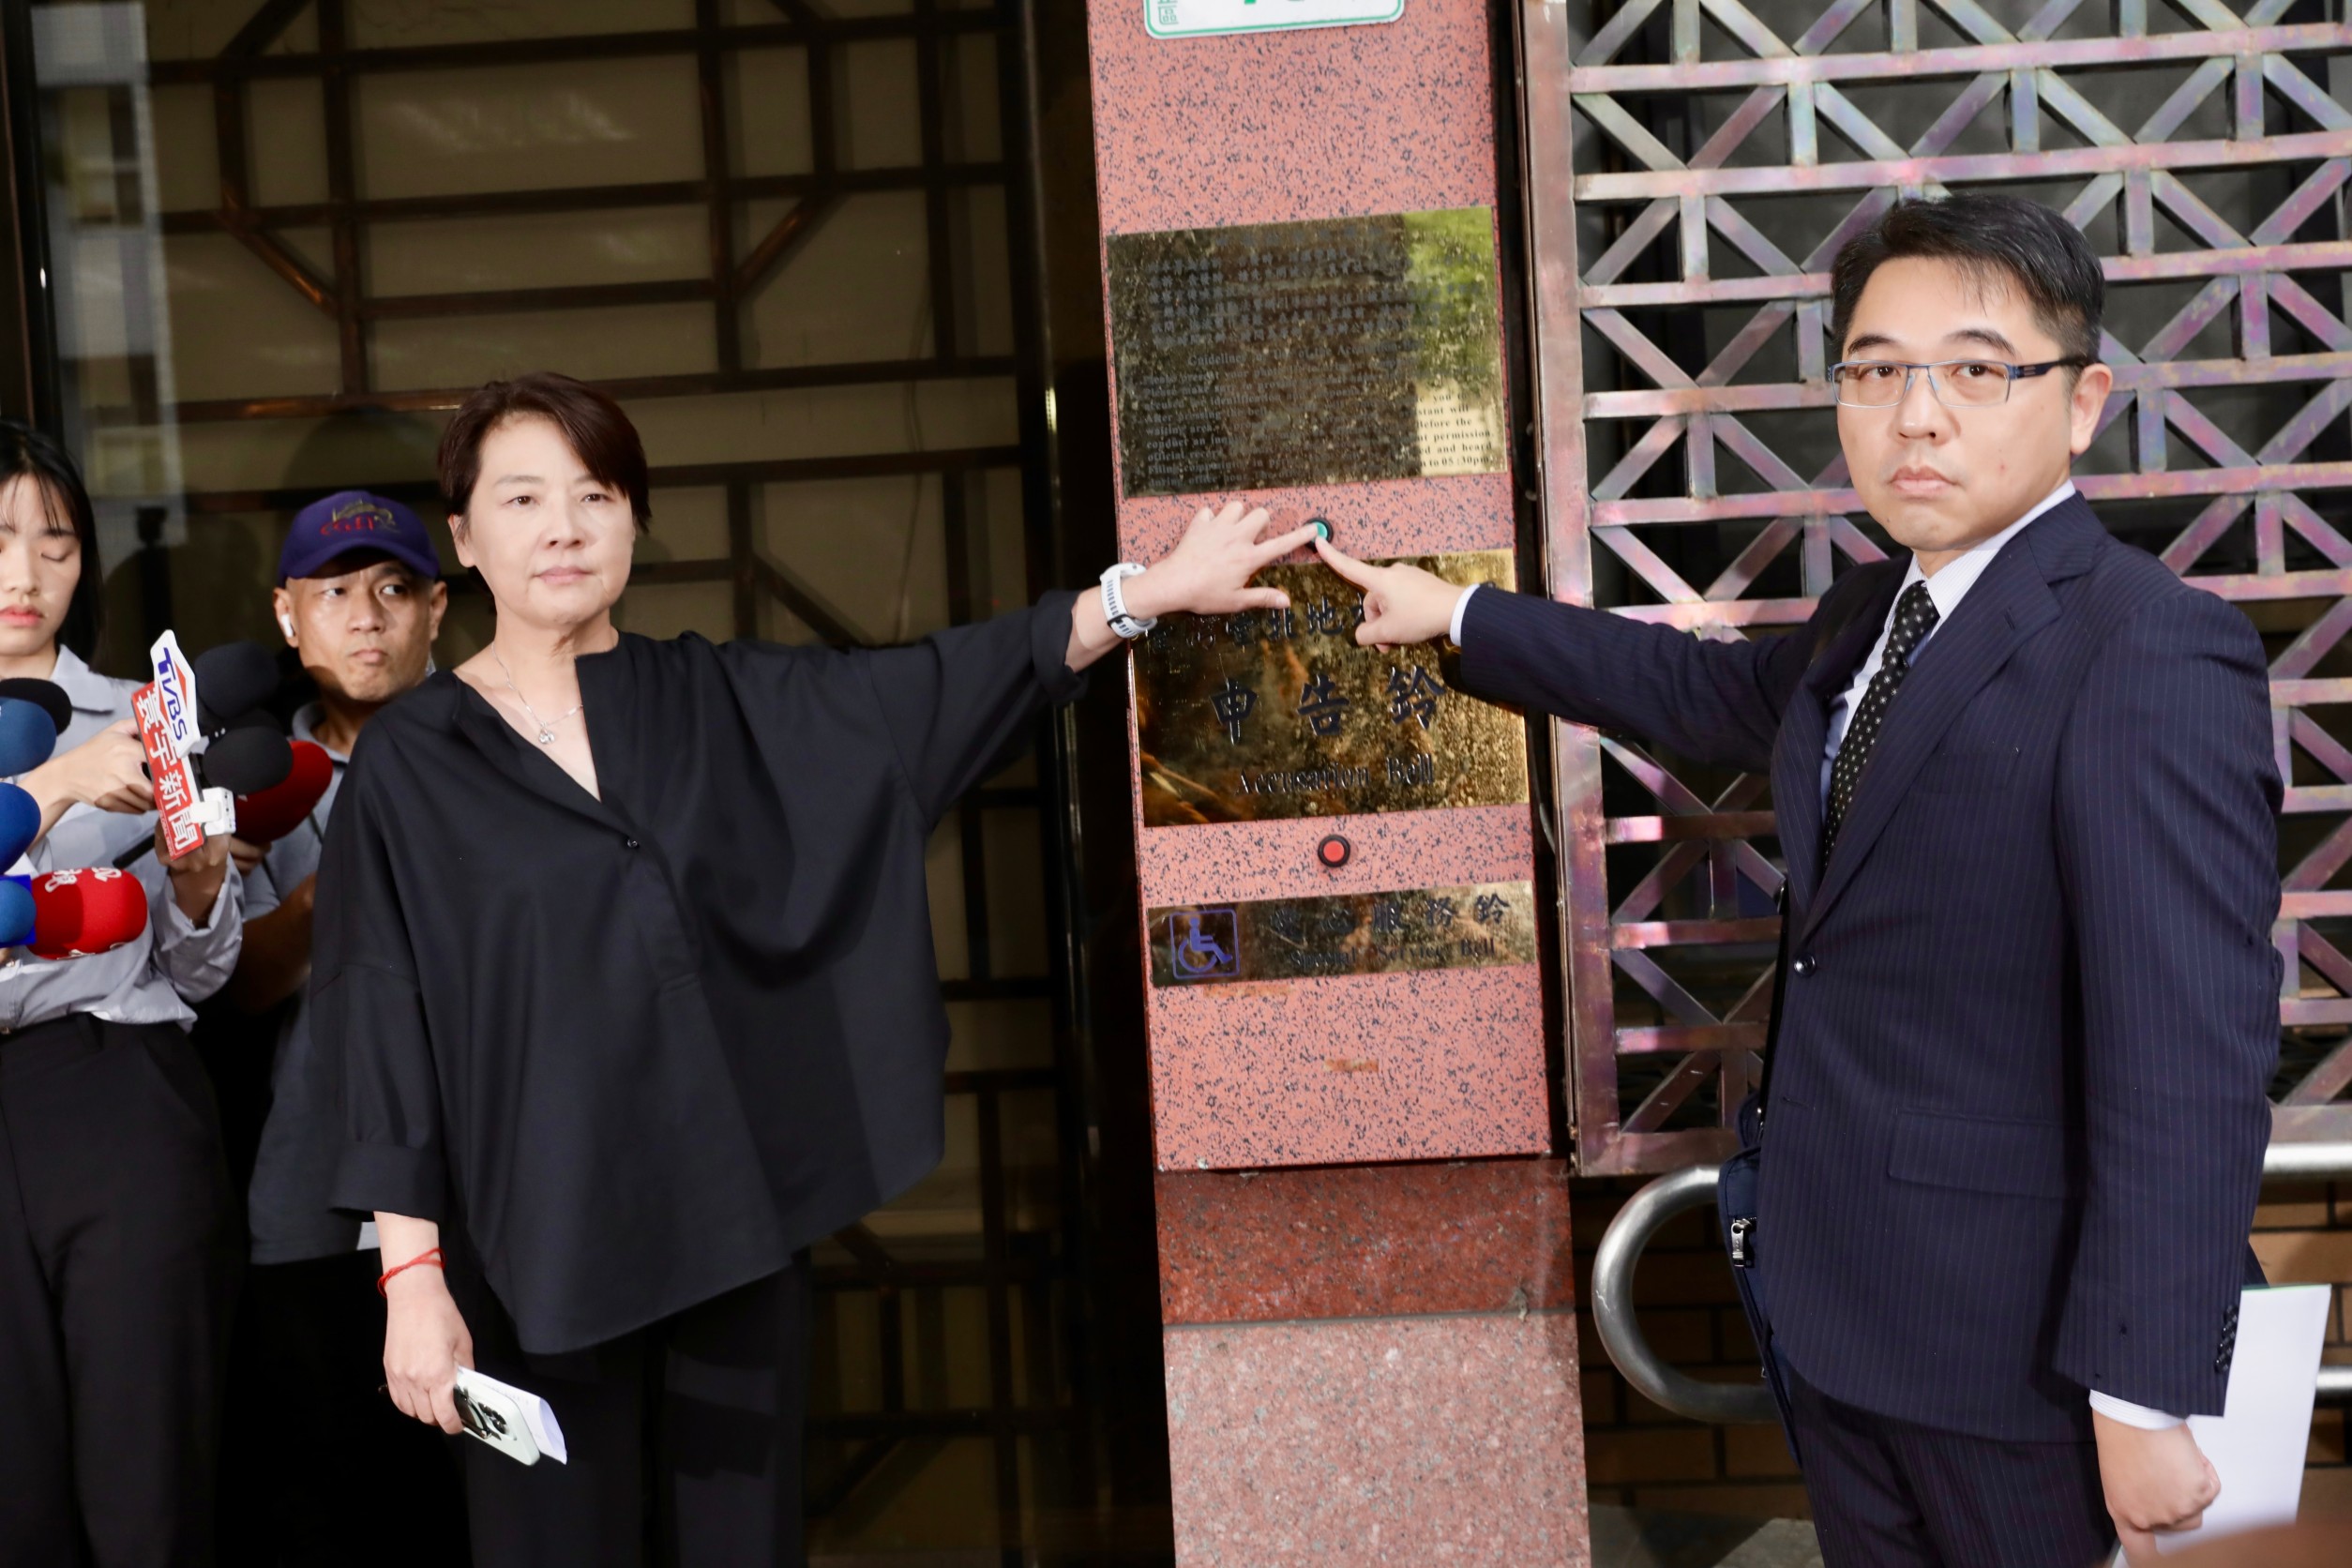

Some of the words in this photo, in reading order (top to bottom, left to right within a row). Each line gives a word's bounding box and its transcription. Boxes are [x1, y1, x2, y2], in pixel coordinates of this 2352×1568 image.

[1438, 444, 1455, 454] and
[158, 646, 188, 741] TVBS
[1209, 664, 1446, 746] 申告鈴
[1235, 761, 1371, 797] Accusation
[1386, 753, 1435, 787] Bell
[1459, 936, 1497, 957] Bell
